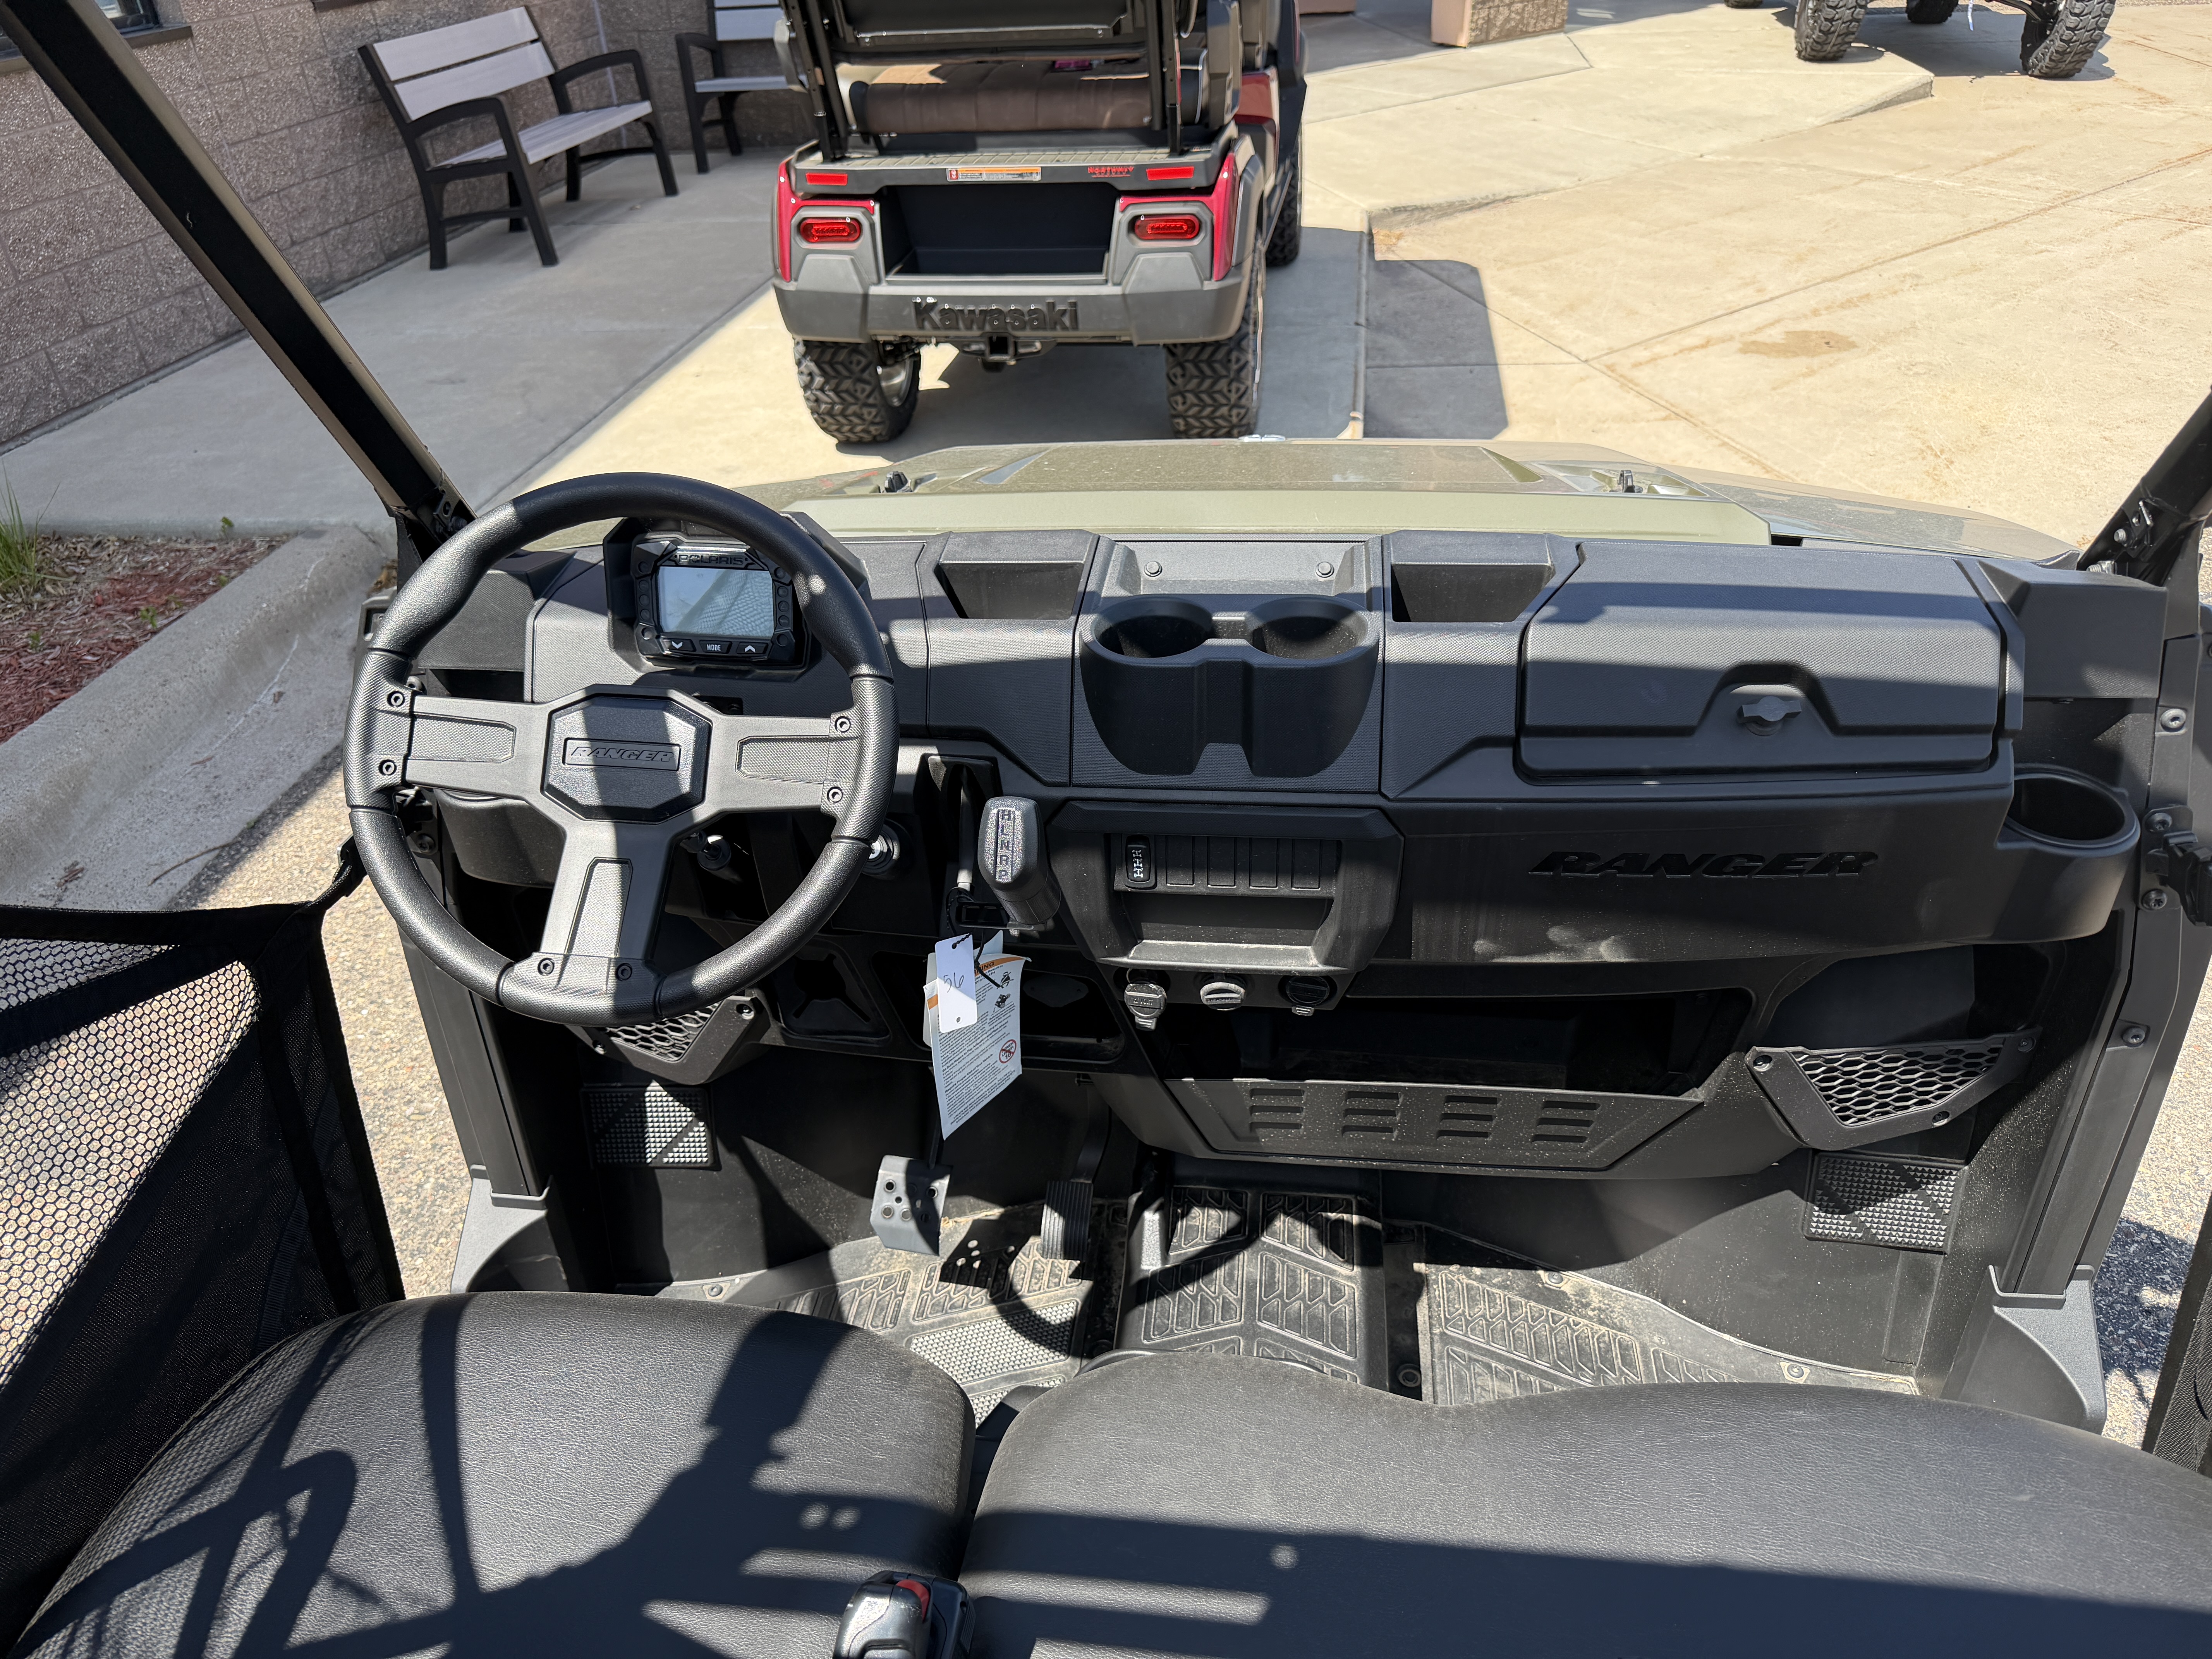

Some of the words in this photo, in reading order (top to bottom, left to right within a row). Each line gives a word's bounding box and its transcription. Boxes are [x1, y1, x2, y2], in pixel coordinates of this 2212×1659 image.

[912, 297, 1079, 330] Kawasaki
[679, 554, 744, 565] POLARIS
[571, 747, 674, 762] RANGER
[1001, 810, 1011, 821] H
[1001, 824, 1010, 836] L
[1001, 840, 1010, 851] N
[1000, 855, 1009, 866] R
[1528, 852, 1879, 879] RANGER
[999, 869, 1008, 880] P
